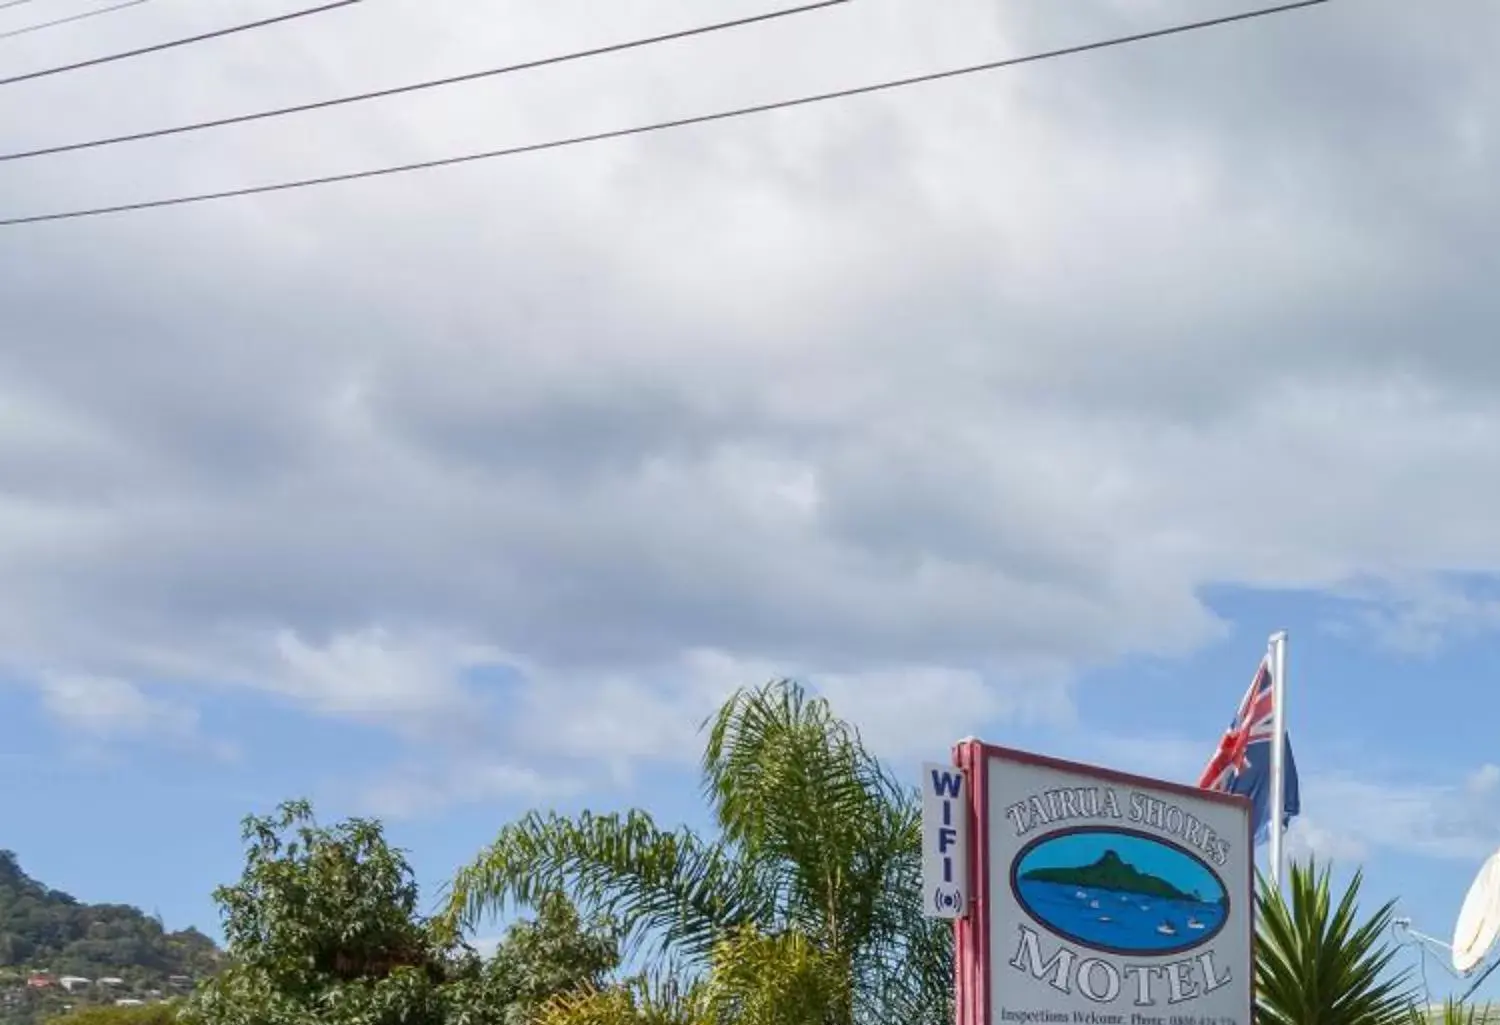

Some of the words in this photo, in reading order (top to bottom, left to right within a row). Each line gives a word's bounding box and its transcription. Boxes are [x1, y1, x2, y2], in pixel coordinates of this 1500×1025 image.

[1007, 786, 1122, 837] TAIRUA
[1128, 791, 1231, 867] SHORES
[1009, 923, 1232, 1006] MOTEL
